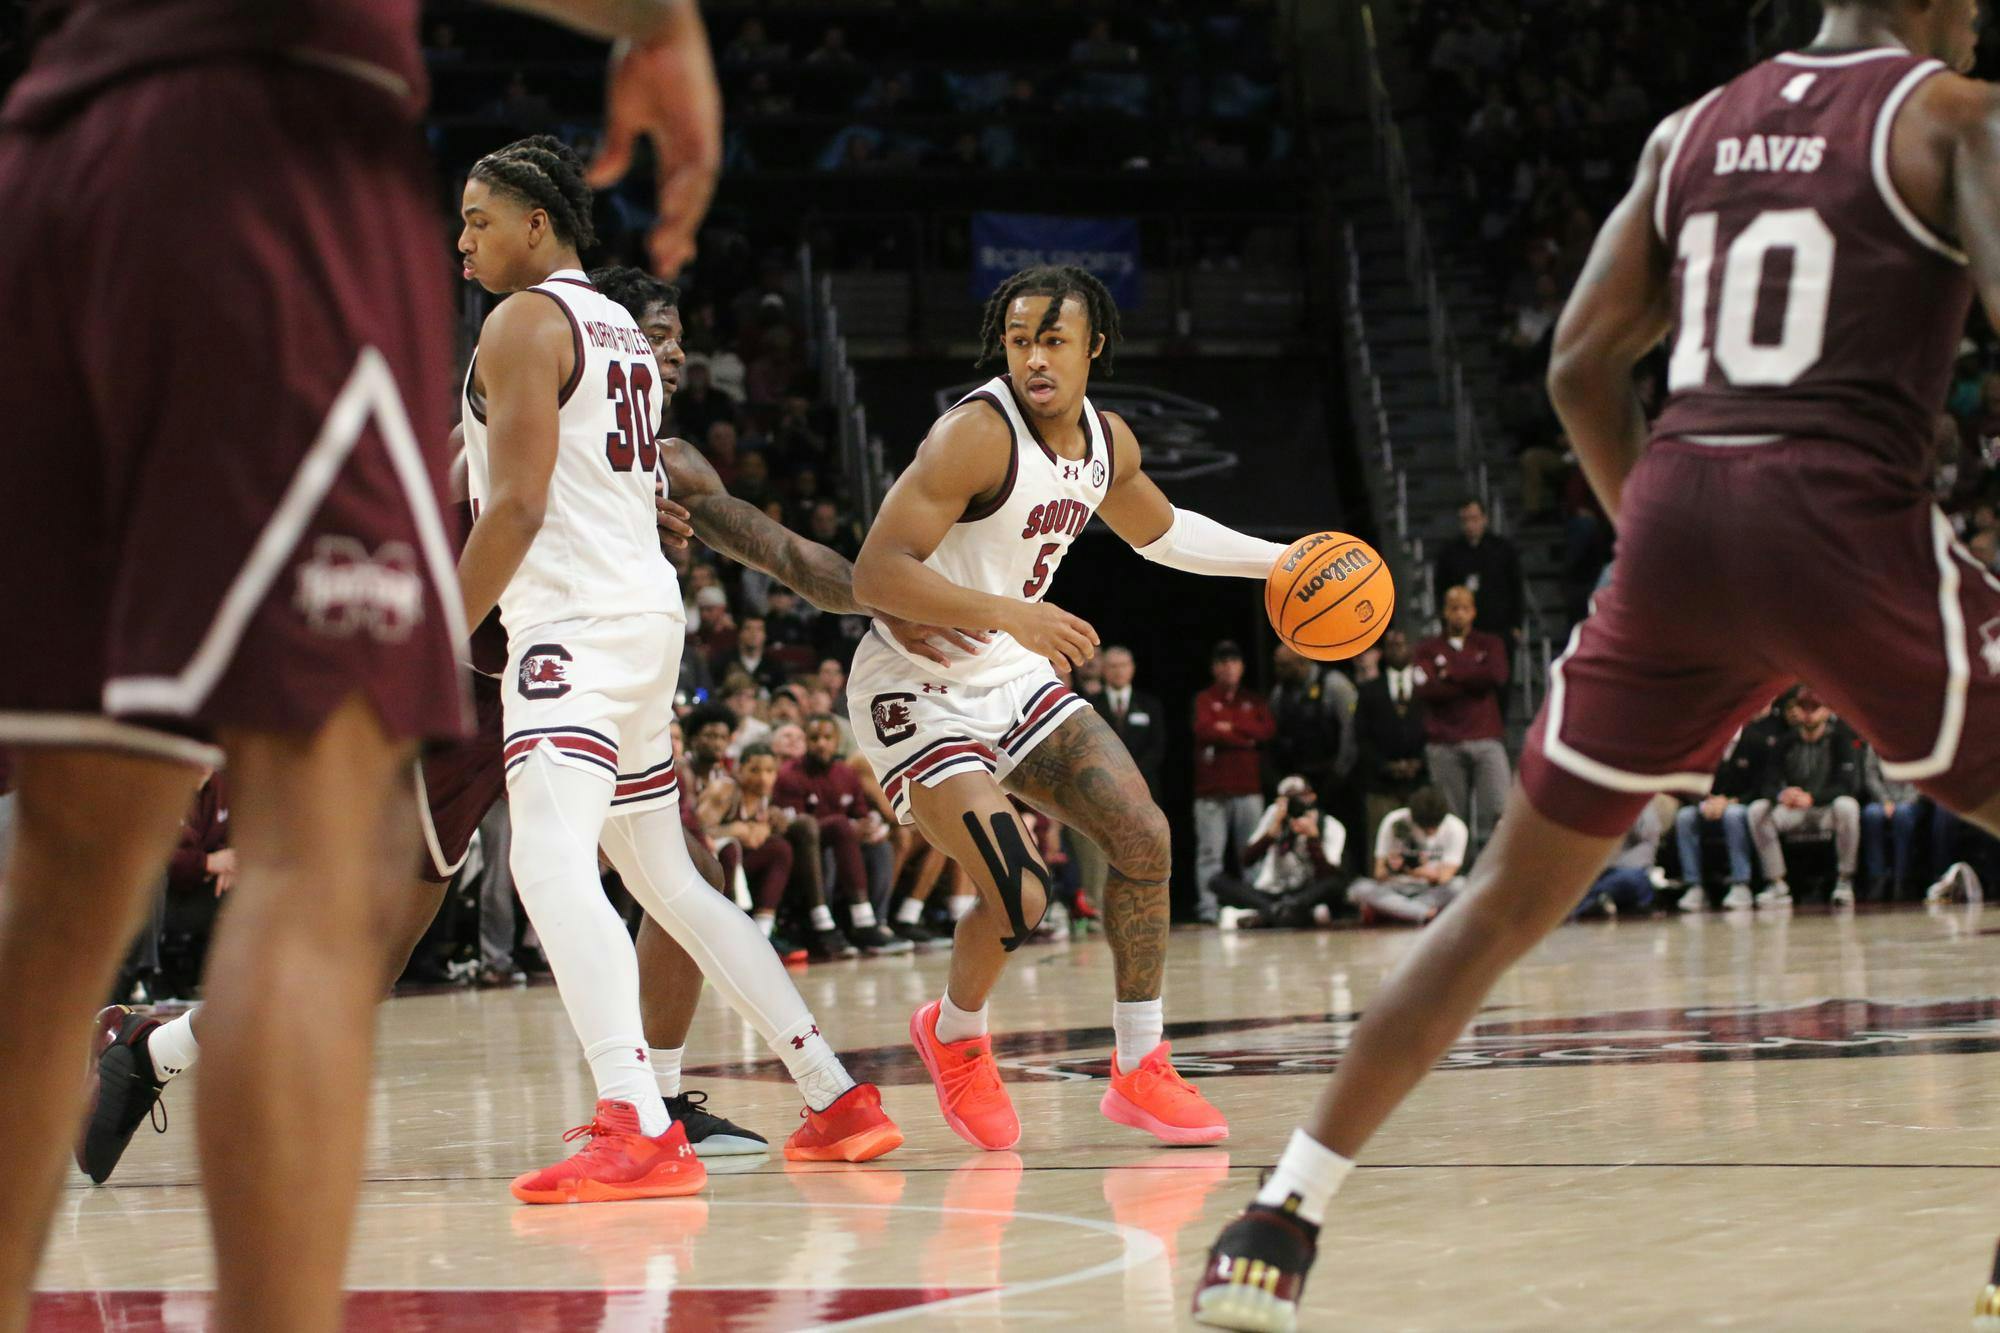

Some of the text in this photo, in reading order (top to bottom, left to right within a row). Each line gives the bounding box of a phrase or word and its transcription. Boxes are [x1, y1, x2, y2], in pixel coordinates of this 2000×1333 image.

[1713, 134, 1827, 176] DAVIS
[1667, 207, 1836, 393] 10
[606, 360, 657, 472] 30
[1021, 498, 1090, 540] SOUTH
[1022, 542, 1061, 598] 5
[1281, 533, 1334, 573] NCAA
[1296, 547, 1373, 603] Wilson
